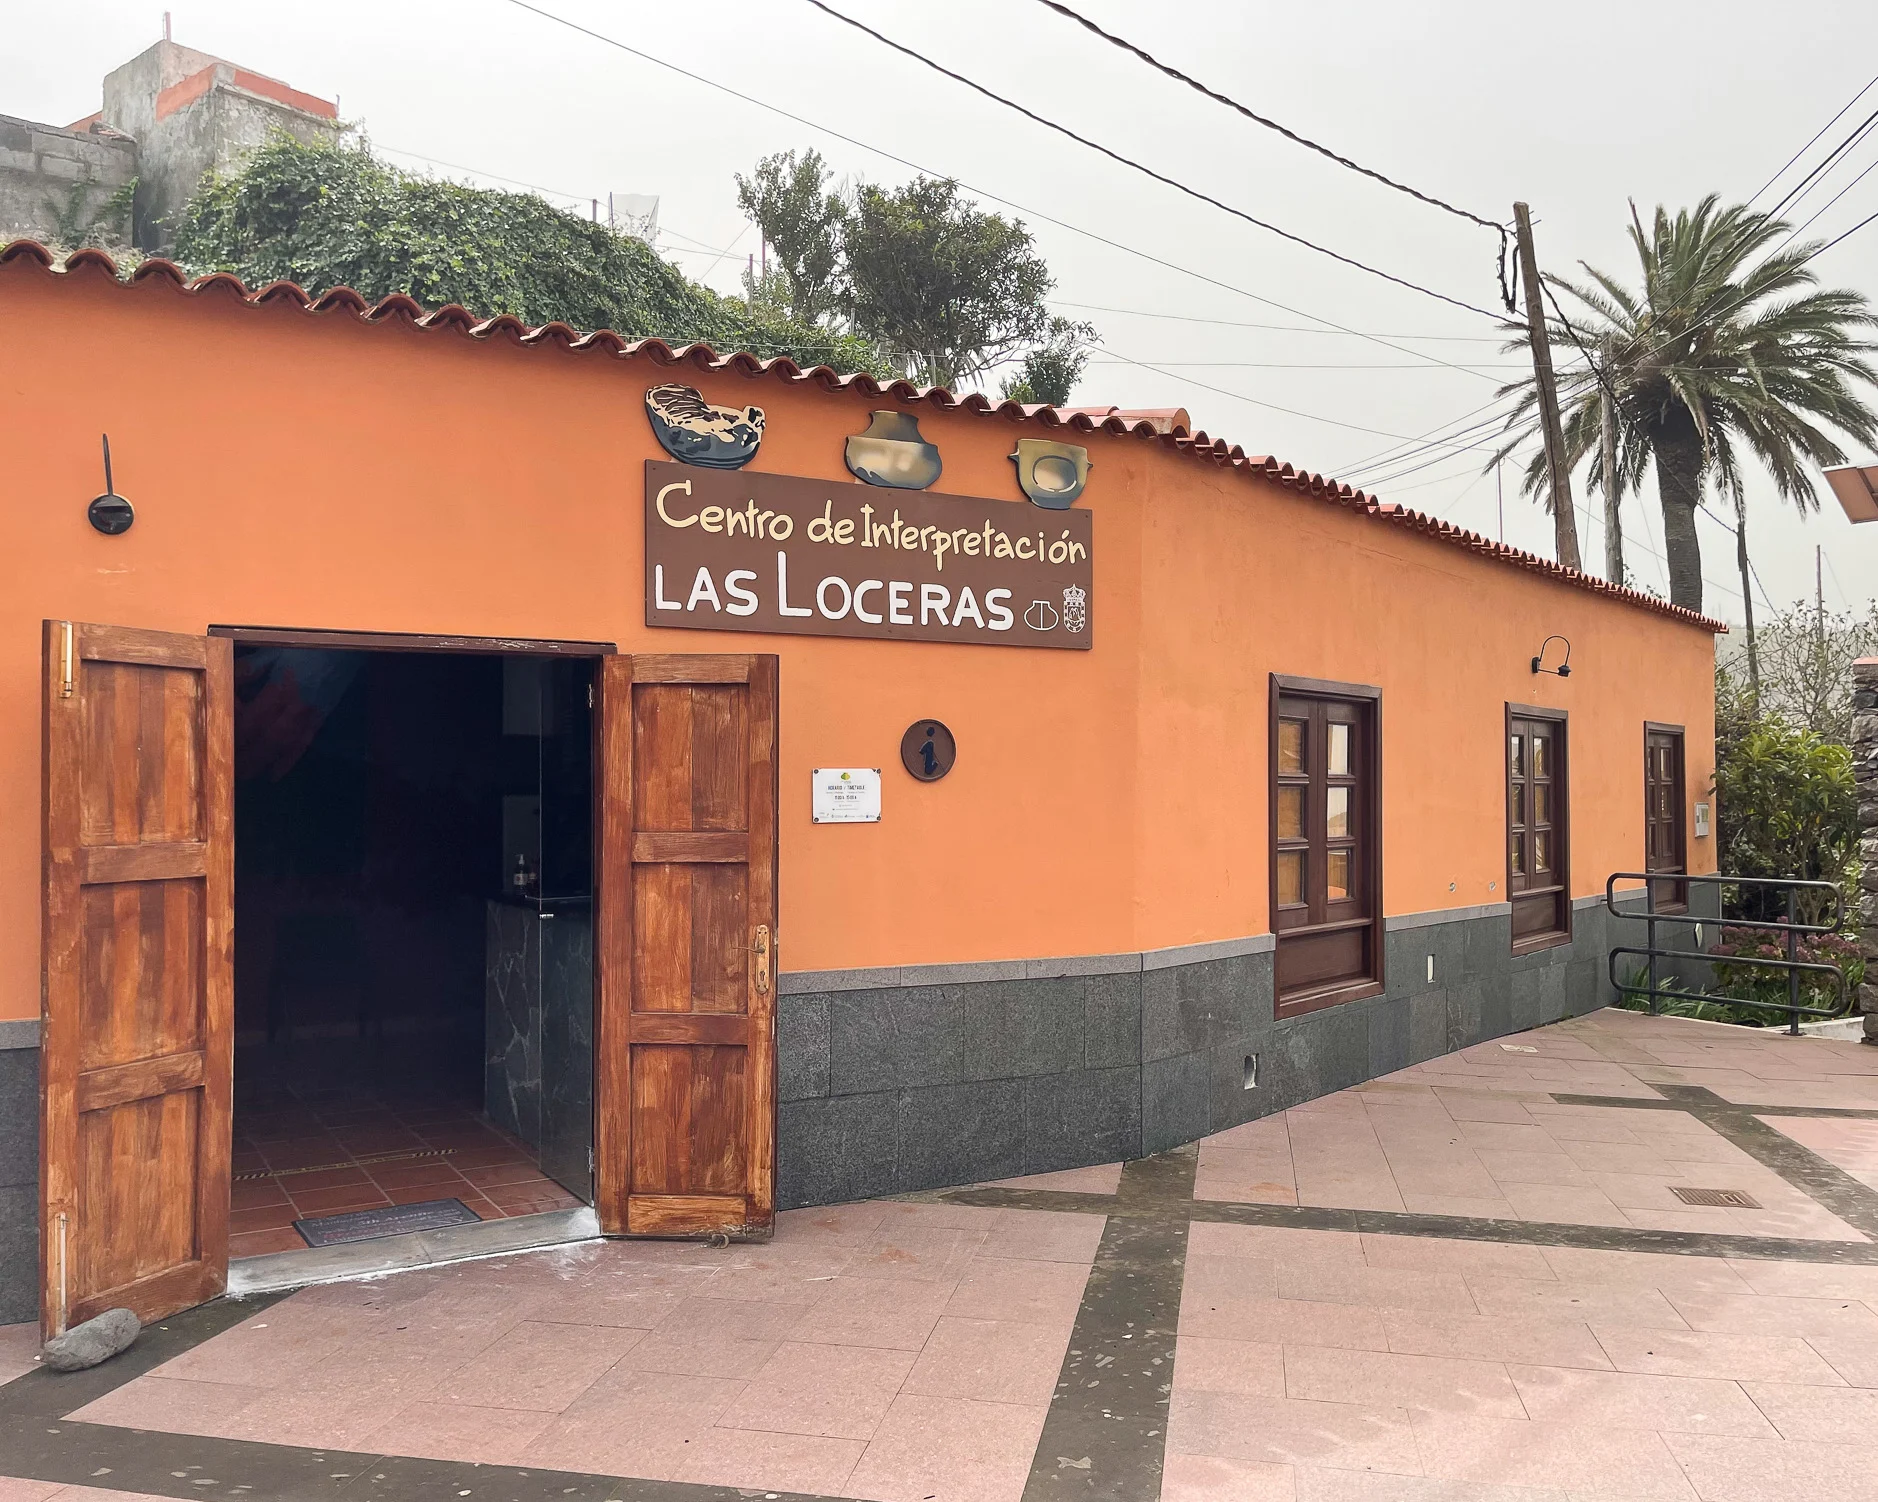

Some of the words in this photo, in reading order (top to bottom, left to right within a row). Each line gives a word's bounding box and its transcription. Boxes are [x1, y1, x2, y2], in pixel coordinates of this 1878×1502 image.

[655, 479, 795, 542] Centro
[806, 499, 855, 546] de
[859, 502, 1088, 572] Interpretación
[654, 563, 760, 617] LAS
[776, 550, 1016, 632] LOCERAS
